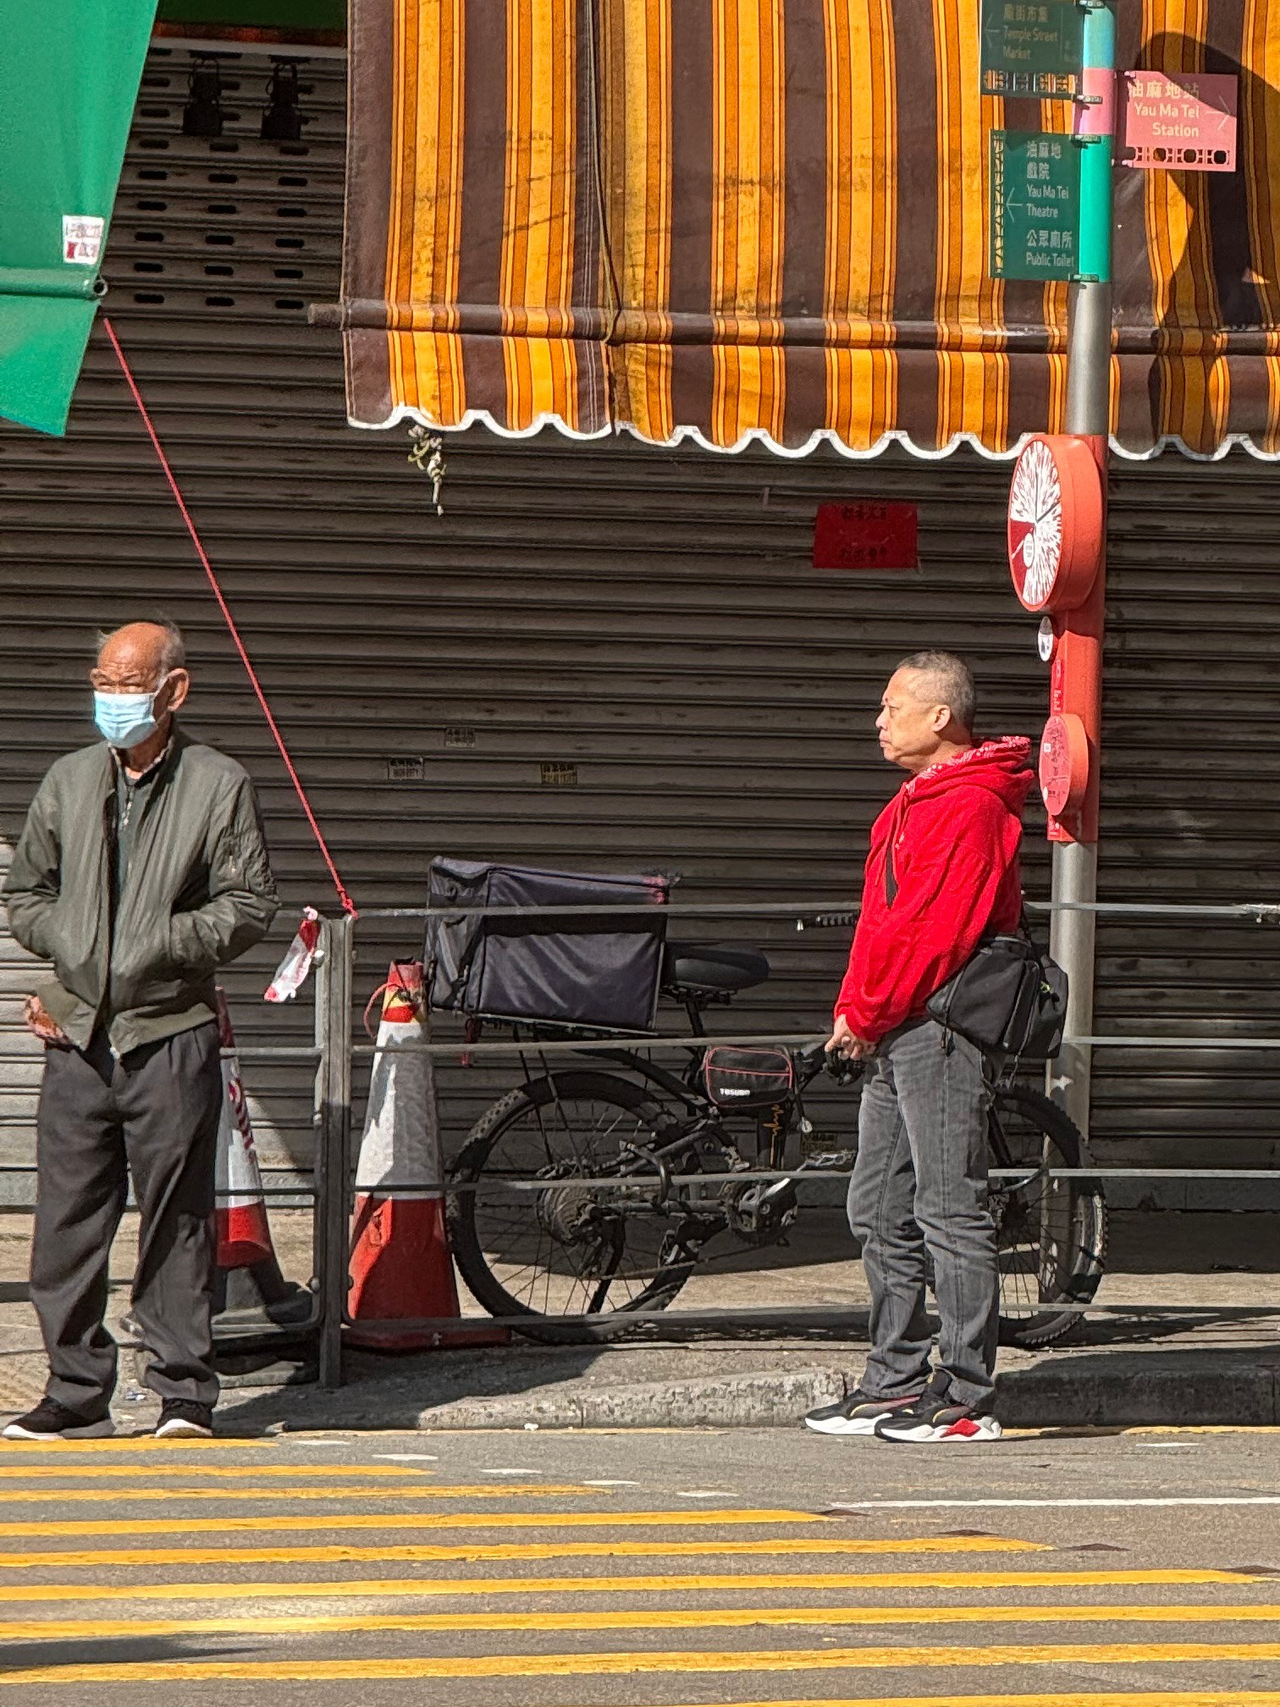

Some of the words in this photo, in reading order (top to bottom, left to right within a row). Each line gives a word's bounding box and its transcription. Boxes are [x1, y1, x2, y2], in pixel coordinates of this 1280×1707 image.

[1003, 25, 1031, 42] Temple
[1033, 27, 1058, 42] Street
[1003, 45, 1031, 60] Market
[1128, 80, 1200, 100] 油麻地站
[1134, 102, 1156, 117] Yau
[1159, 103, 1179, 117] Ma
[1181, 104, 1200, 119] Tei
[1152, 122, 1199, 137] Station
[1027, 140, 1062, 159] 油麻地
[1027, 184, 1041, 198] Yau
[1043, 185, 1055, 199] Ma
[1057, 186, 1069, 200] Tei
[1027, 203, 1059, 219] Theatre
[1026, 251, 1050, 267] Public
[1053, 253, 1075, 268] Toilet
